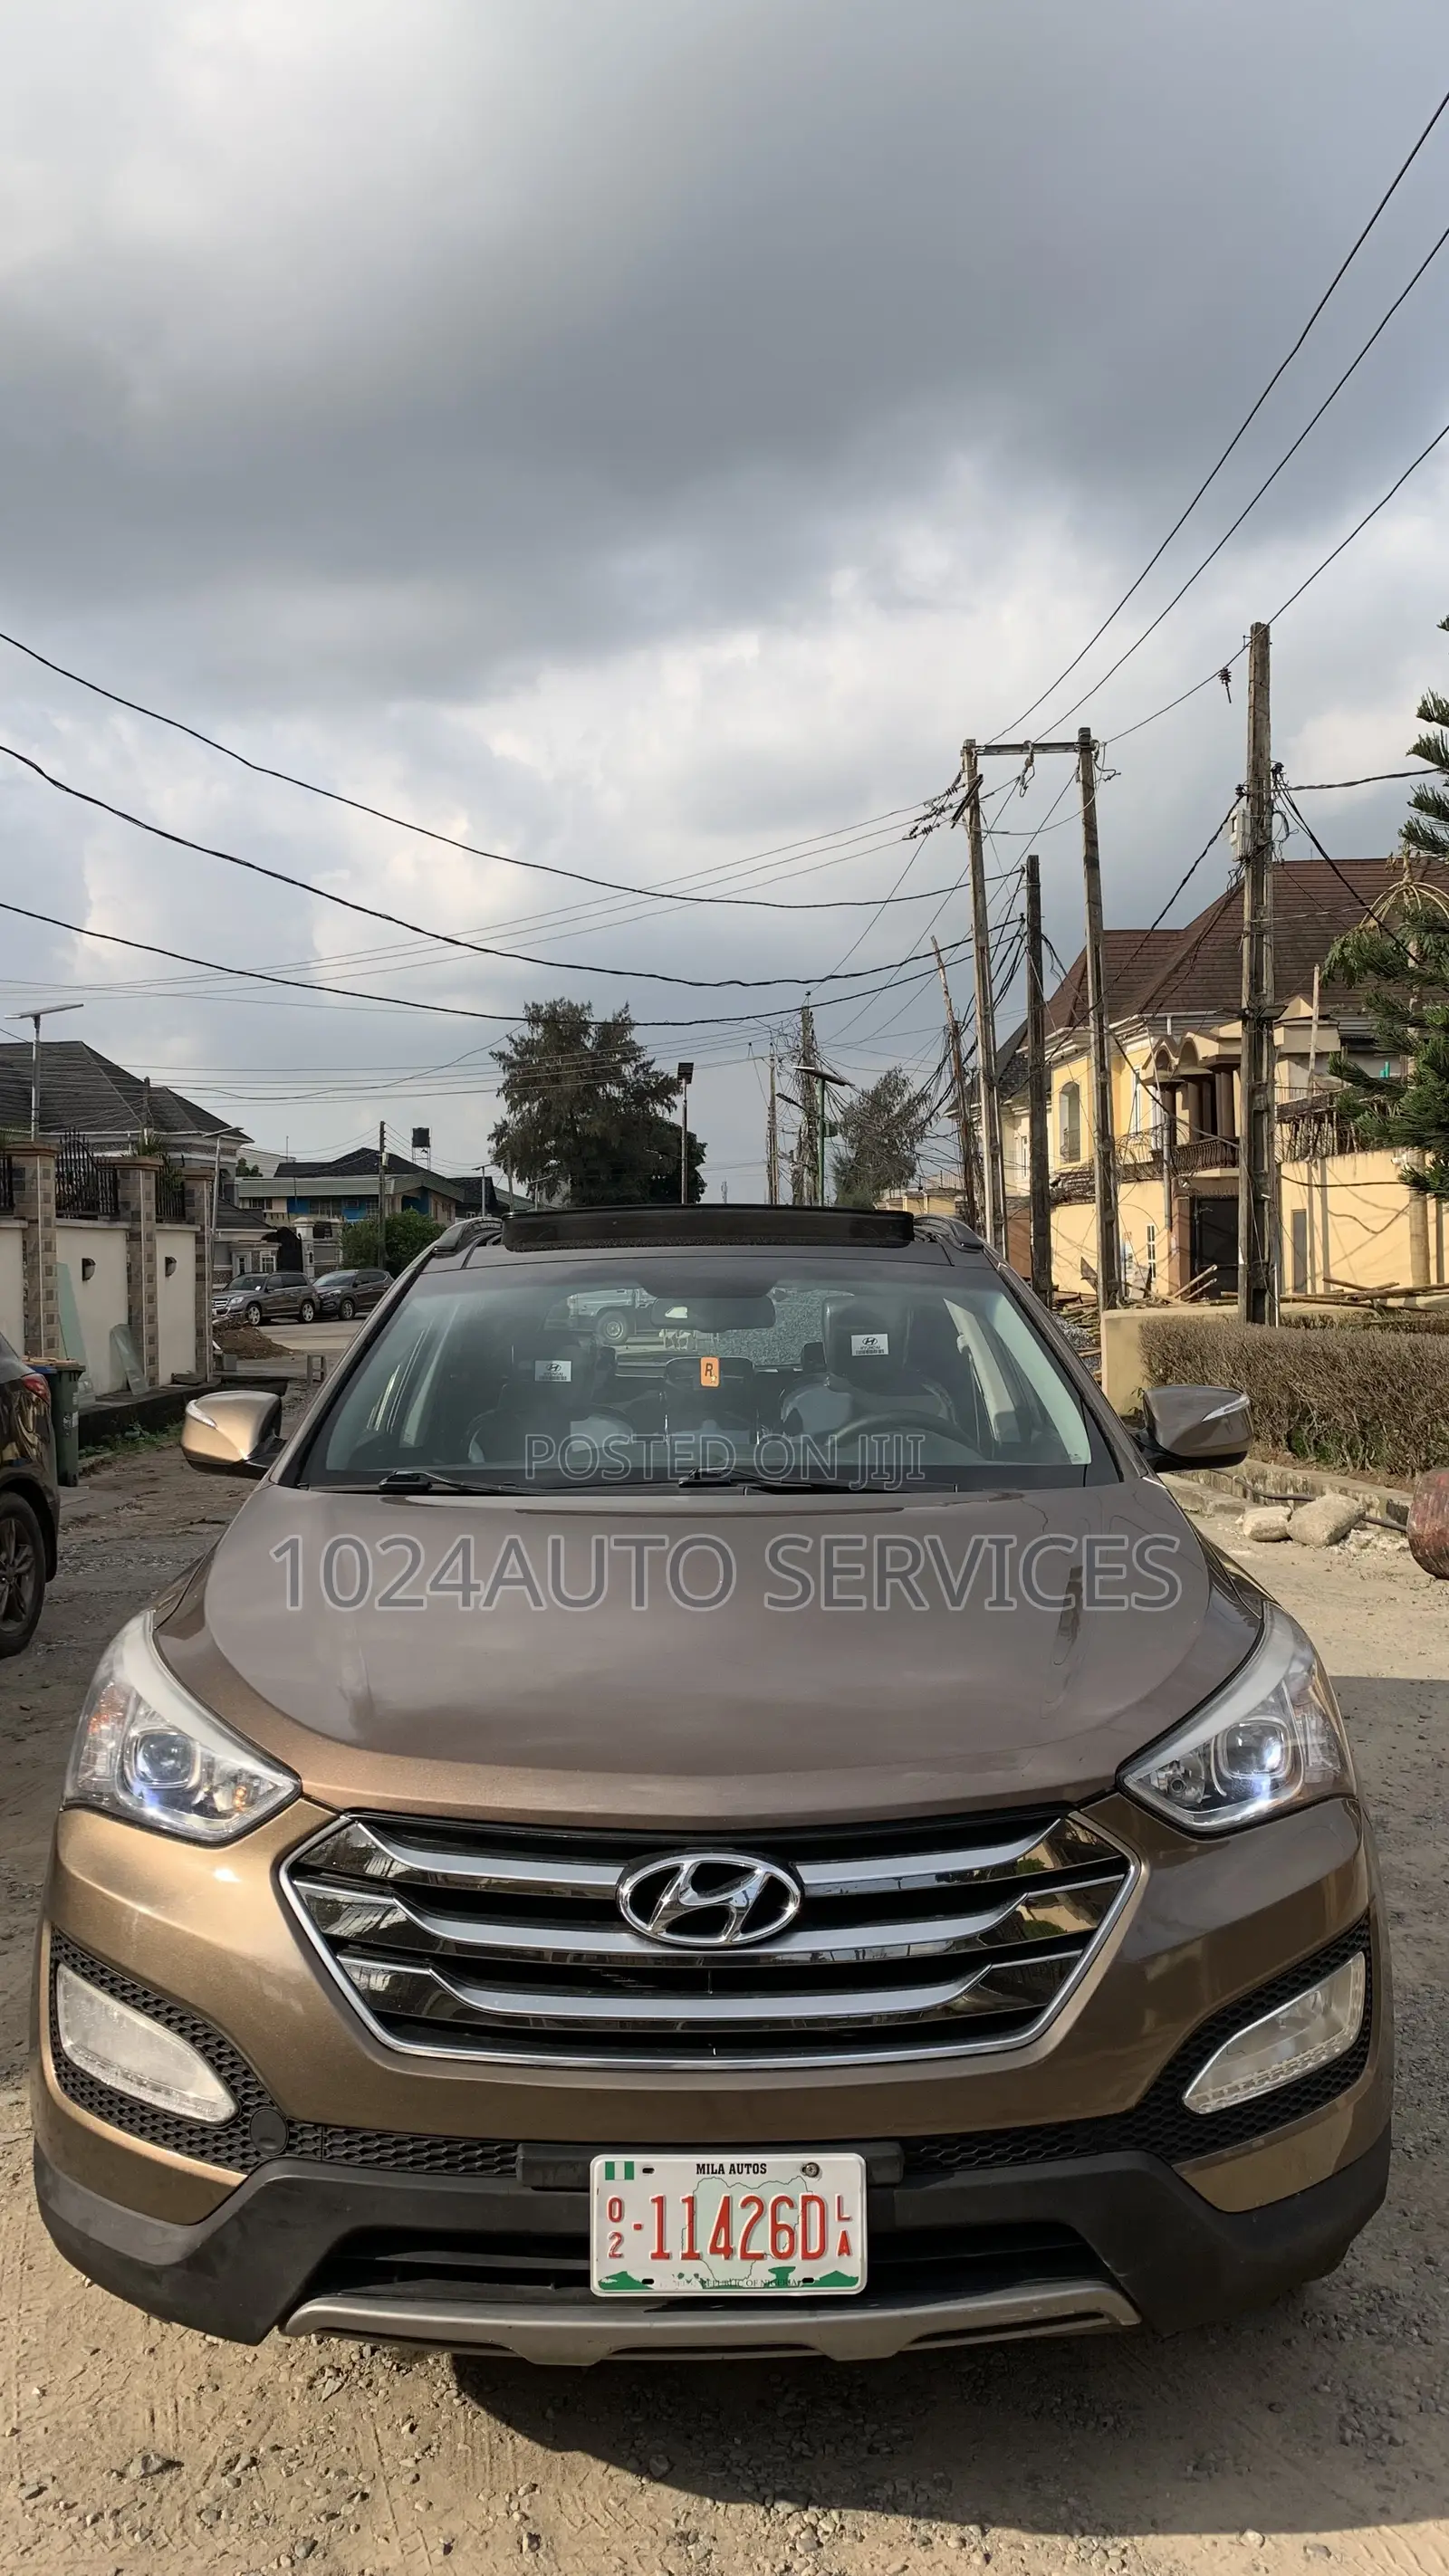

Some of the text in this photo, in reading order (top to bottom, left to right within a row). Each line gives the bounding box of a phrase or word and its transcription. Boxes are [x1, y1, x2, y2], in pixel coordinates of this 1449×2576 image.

[705, 1362, 714, 1377] R
[696, 2162, 767, 2175] MILA AUTOS
[745, 2279, 756, 2287] OF
